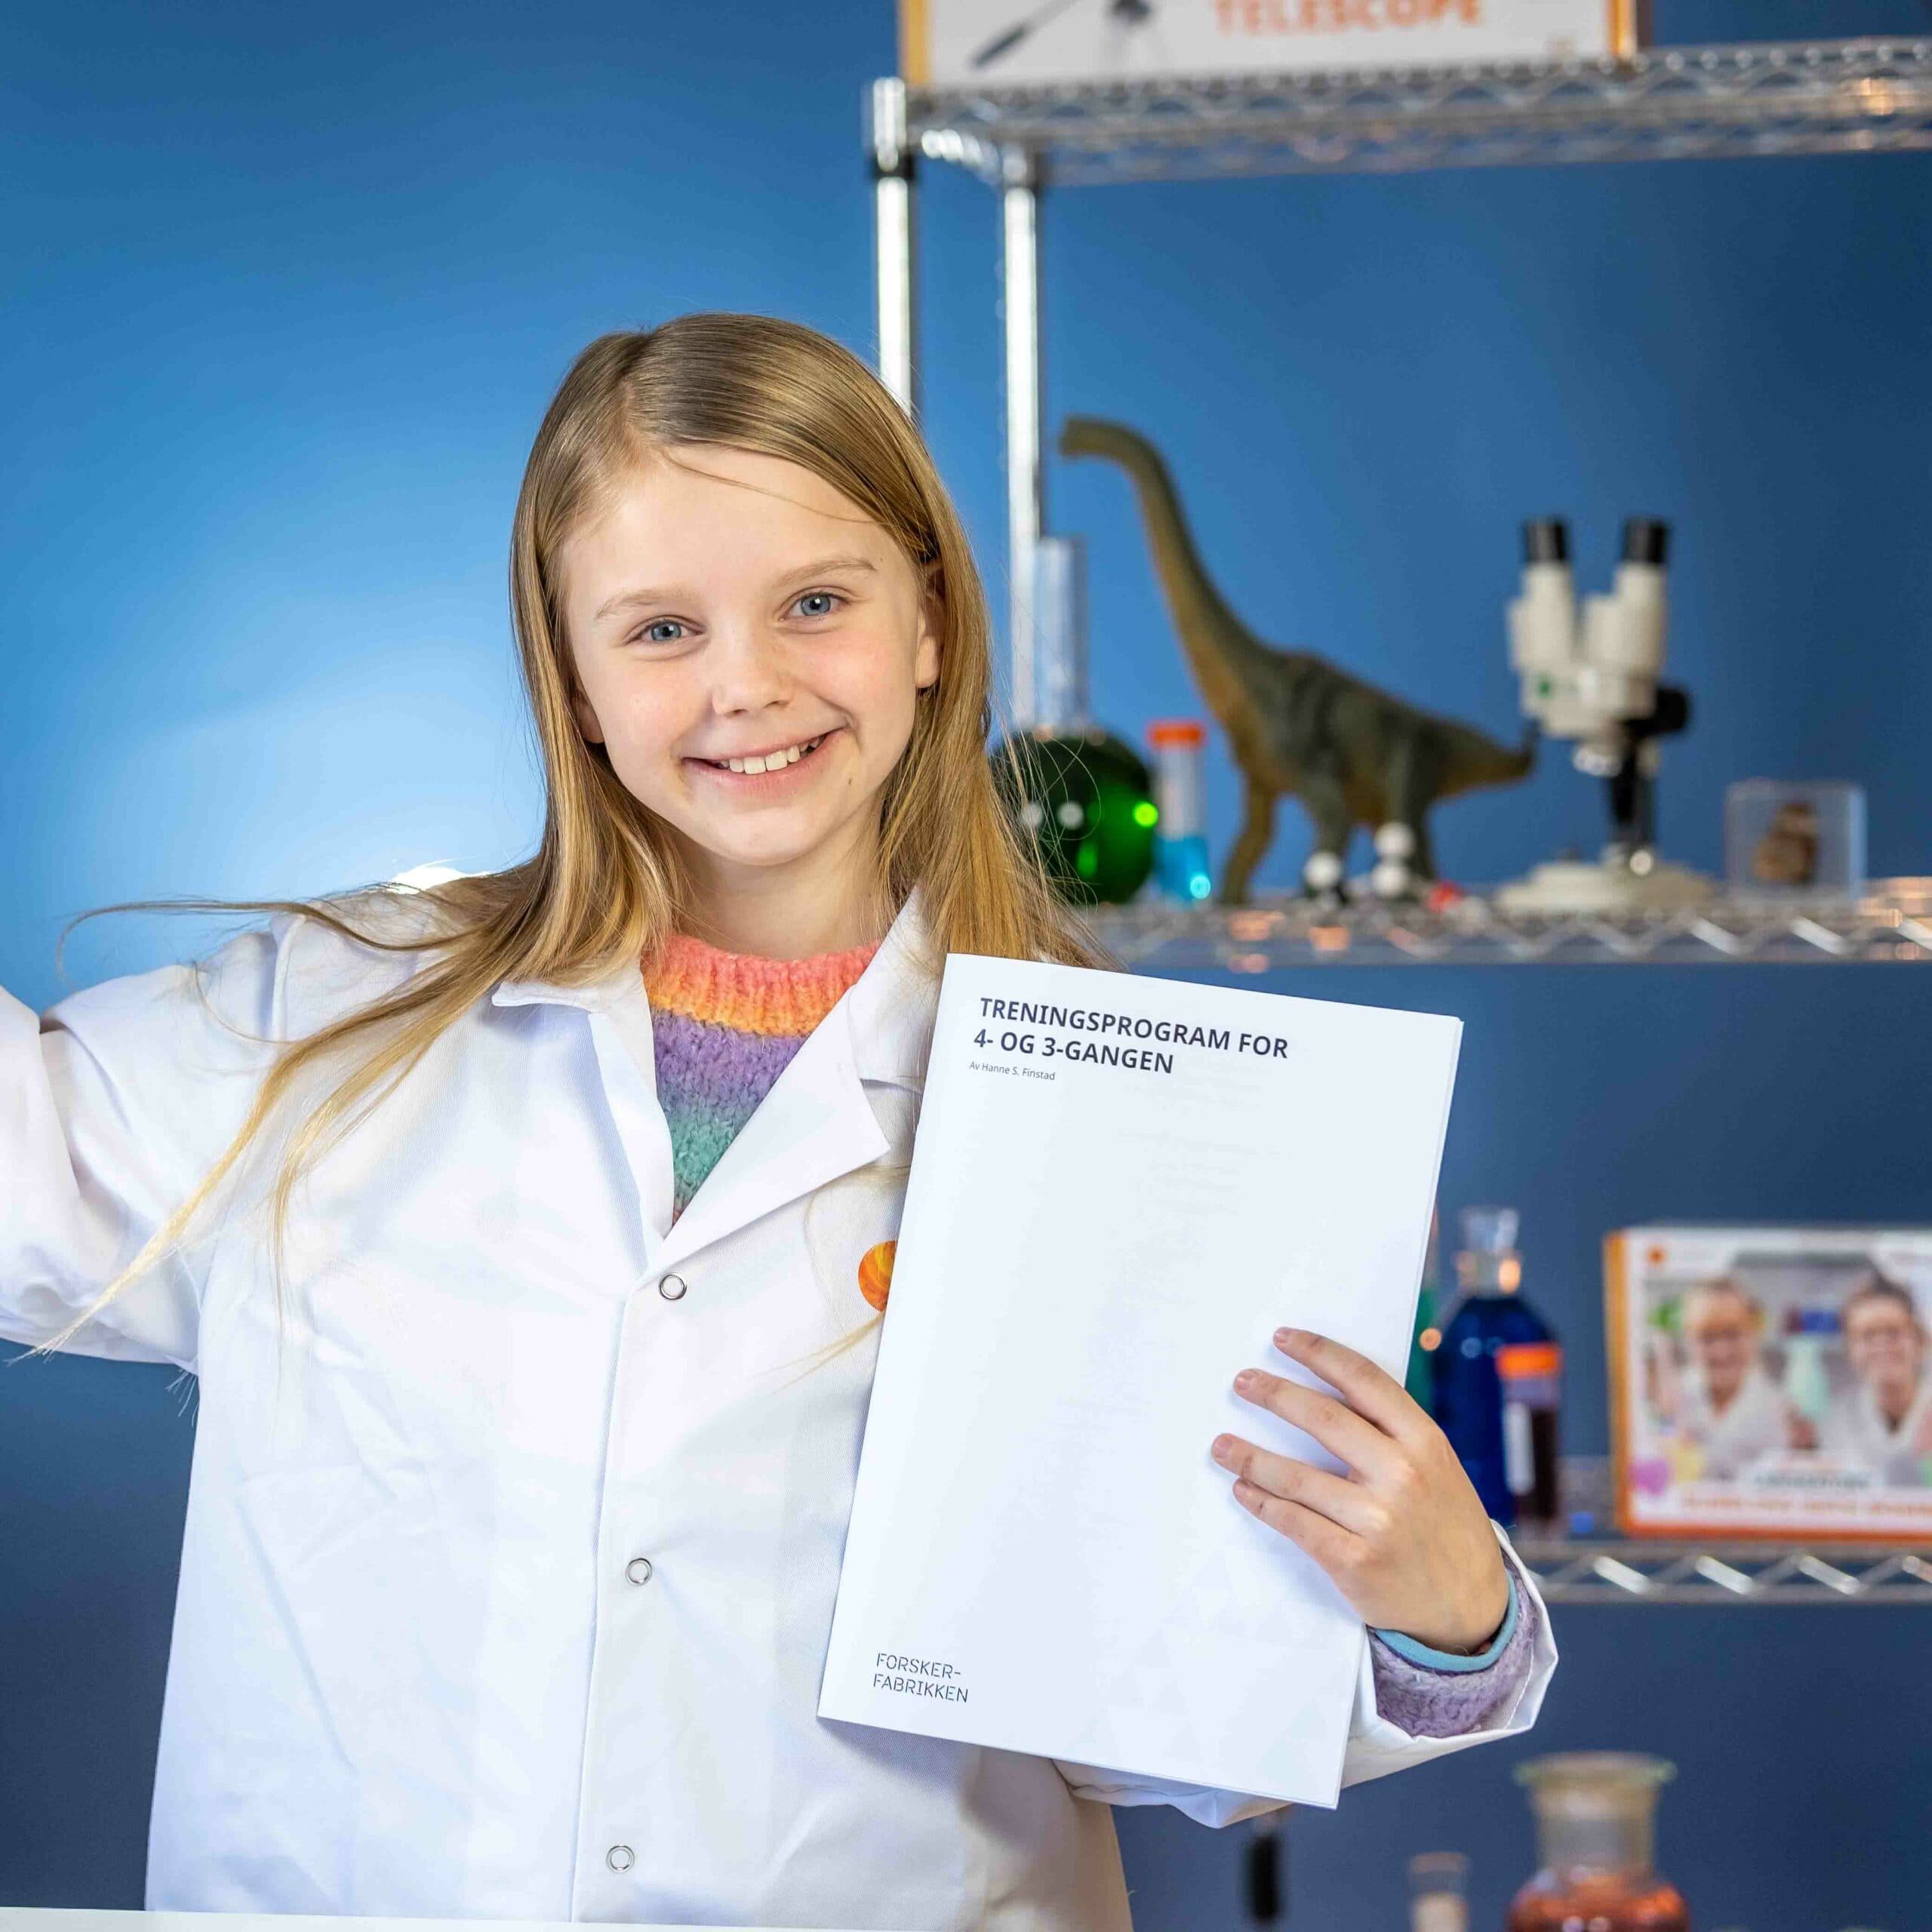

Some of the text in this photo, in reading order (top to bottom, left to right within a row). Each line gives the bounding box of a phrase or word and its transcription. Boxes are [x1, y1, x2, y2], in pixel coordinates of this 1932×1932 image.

[980, 997, 1289, 1060] TRENINGSPROGRAM FOR
[974, 1028, 1174, 1074] 4- OG 3-GANGEN
[970, 1061, 1056, 1081] Av Hanne S. Finstad
[876, 1653, 961, 1680] FORSKER-
[872, 1673, 969, 1703] FABRIKKEN
